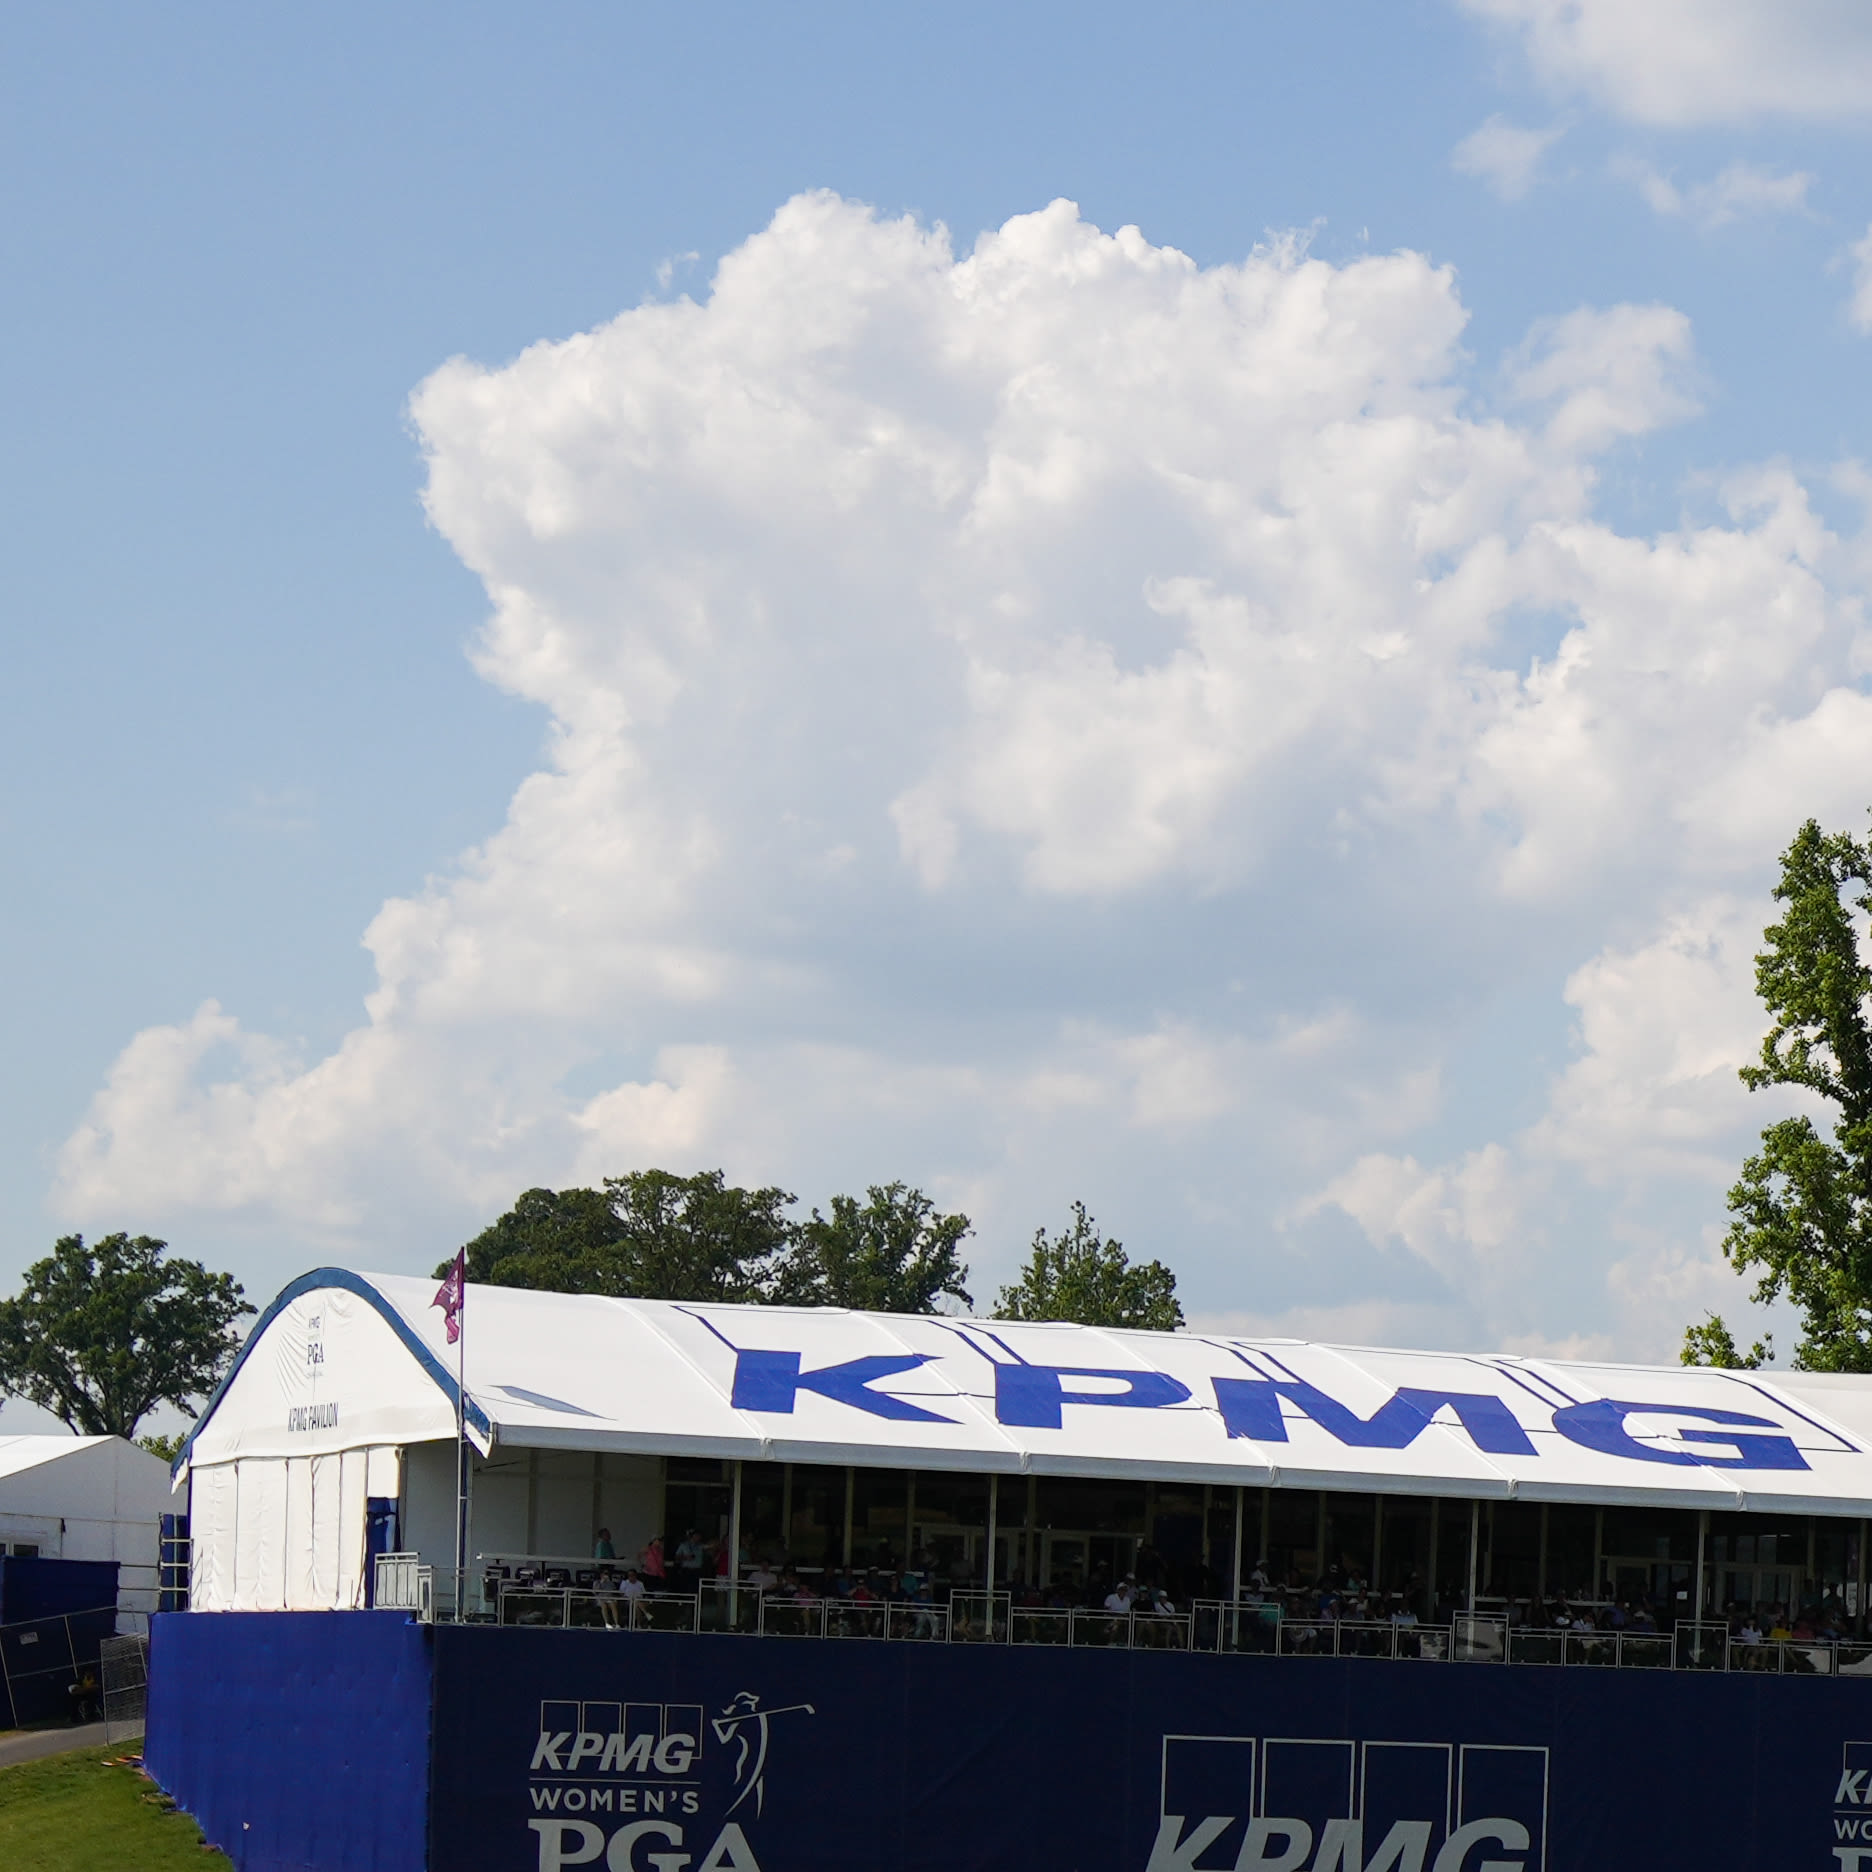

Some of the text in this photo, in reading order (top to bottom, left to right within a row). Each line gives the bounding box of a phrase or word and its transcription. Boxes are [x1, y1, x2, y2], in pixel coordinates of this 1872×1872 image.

[308, 1402, 339, 1431] PAVILION
[731, 1347, 1813, 1472] KPMG
[529, 1731, 697, 1774] KPMG
[529, 1787, 700, 1814] WOMEN'S
